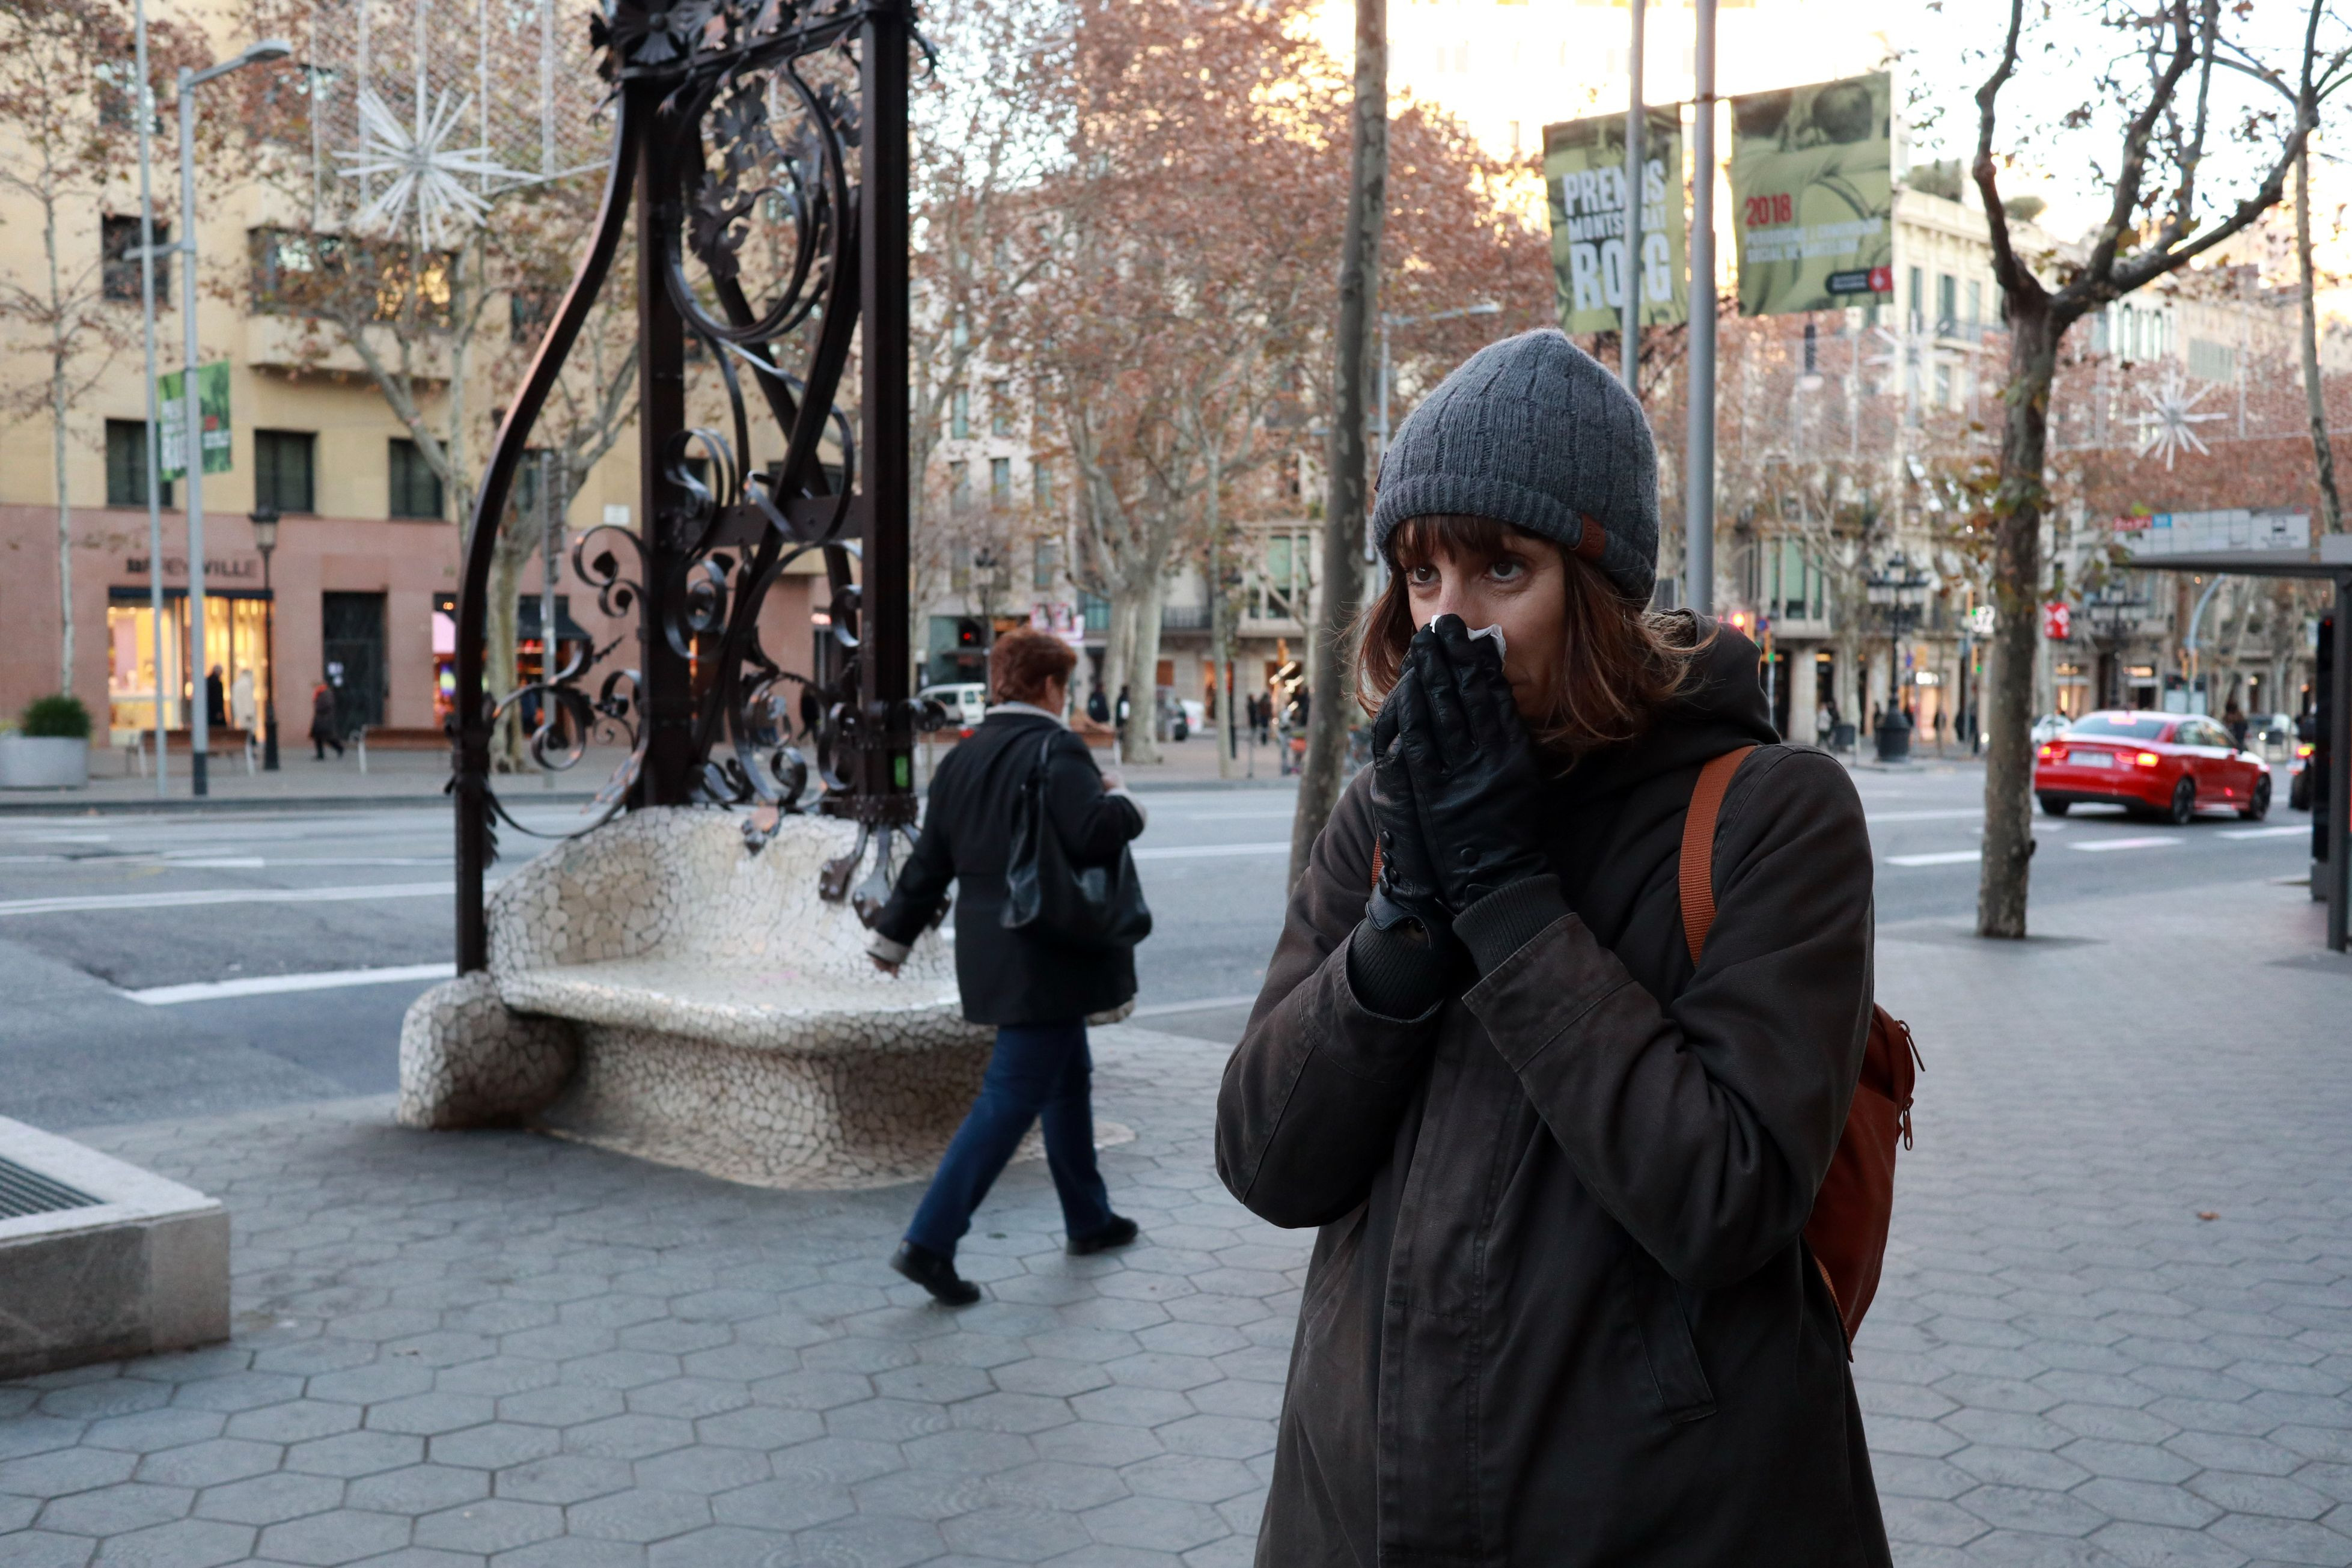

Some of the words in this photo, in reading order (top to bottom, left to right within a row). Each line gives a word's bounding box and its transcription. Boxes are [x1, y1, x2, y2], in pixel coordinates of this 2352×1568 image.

[1566, 204, 1666, 243] MONTSAT
[1746, 192, 1792, 227] 2018
[1570, 233, 1673, 311] ROG
